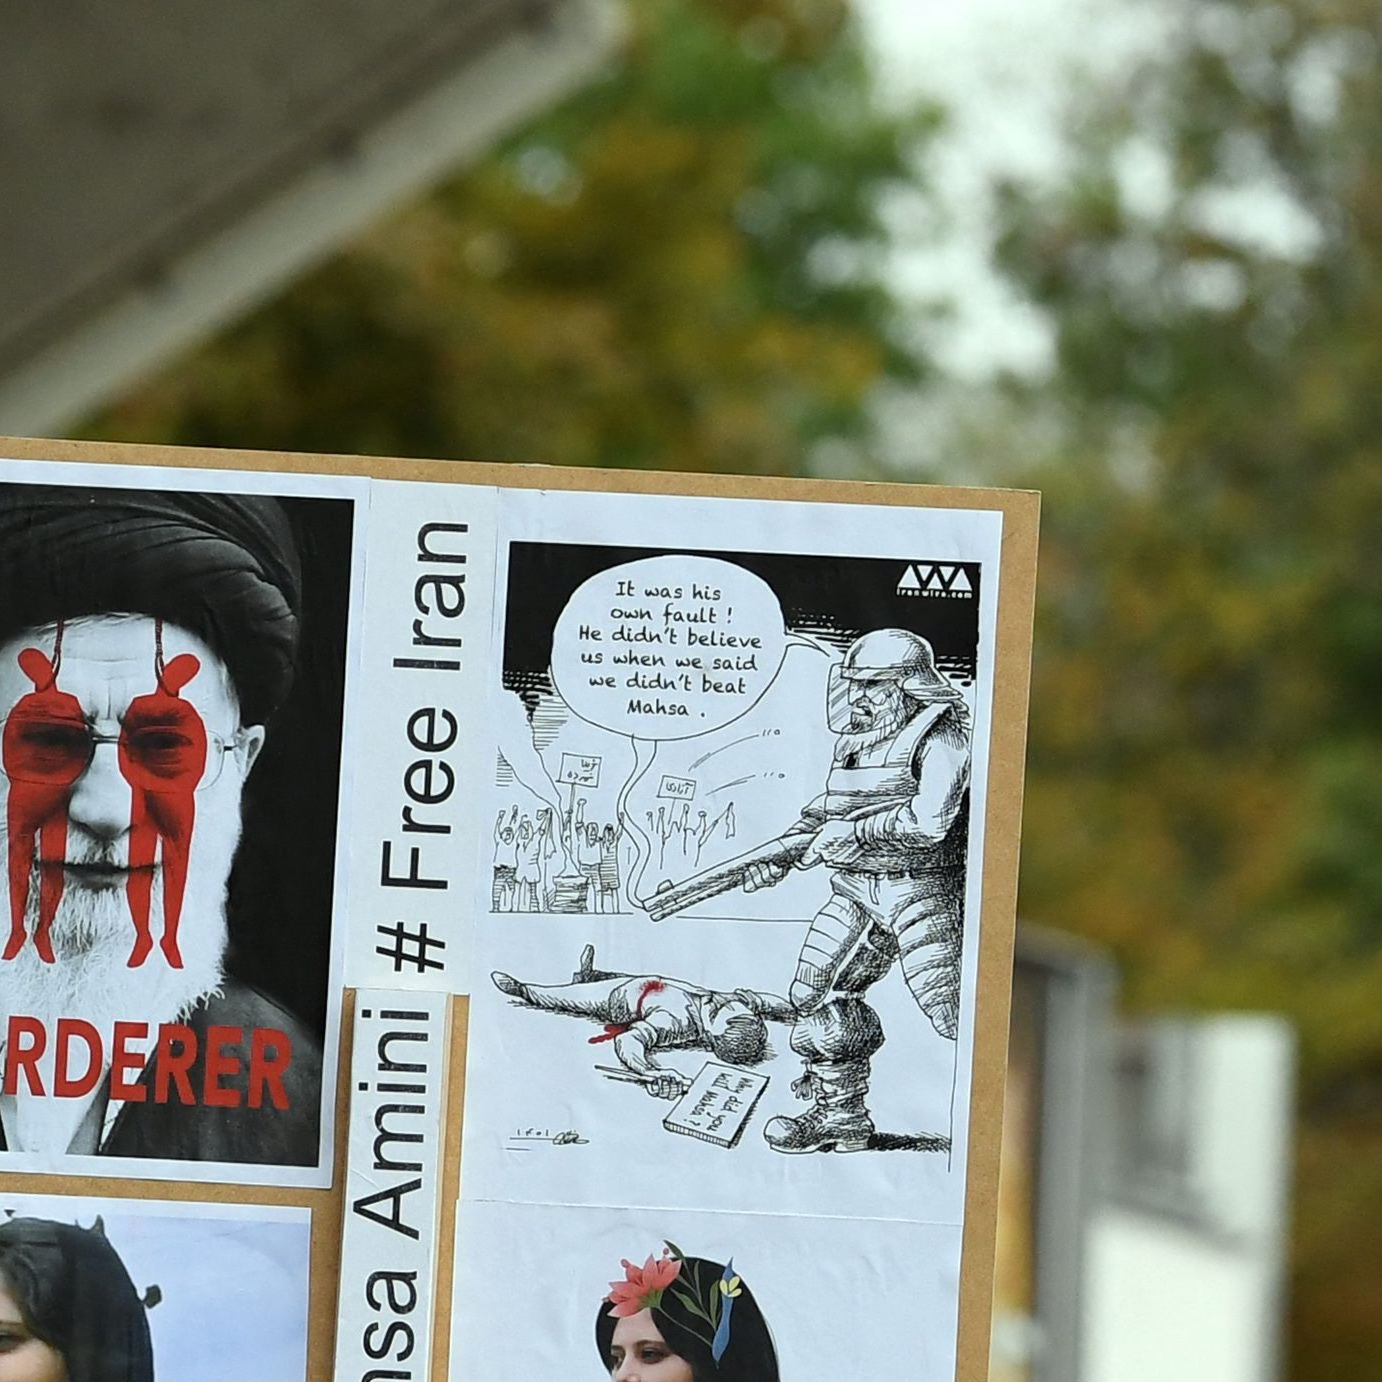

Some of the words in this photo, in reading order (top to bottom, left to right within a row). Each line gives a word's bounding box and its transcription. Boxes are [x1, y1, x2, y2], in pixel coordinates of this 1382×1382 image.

[392, 521, 469, 671] Iran
[615, 580, 635, 597] It
[644, 587, 682, 599] was
[692, 584, 721, 601] his
[610, 607, 653, 621] own
[578, 625, 602, 641] He
[611, 625, 677, 644] didn't
[687, 627, 762, 649] believe
[580, 651, 603, 664] us
[613, 649, 666, 666] when
[675, 657, 703, 669] we
[712, 654, 758, 671] said
[589, 677, 616, 688] we
[626, 672, 692, 691] didn't
[702, 674, 746, 694] beat
[627, 698, 689, 717] Mahsa
[380, 706, 458, 889] Free
[375, 922, 446, 973] #
[353, 1008, 429, 1241] Amini
